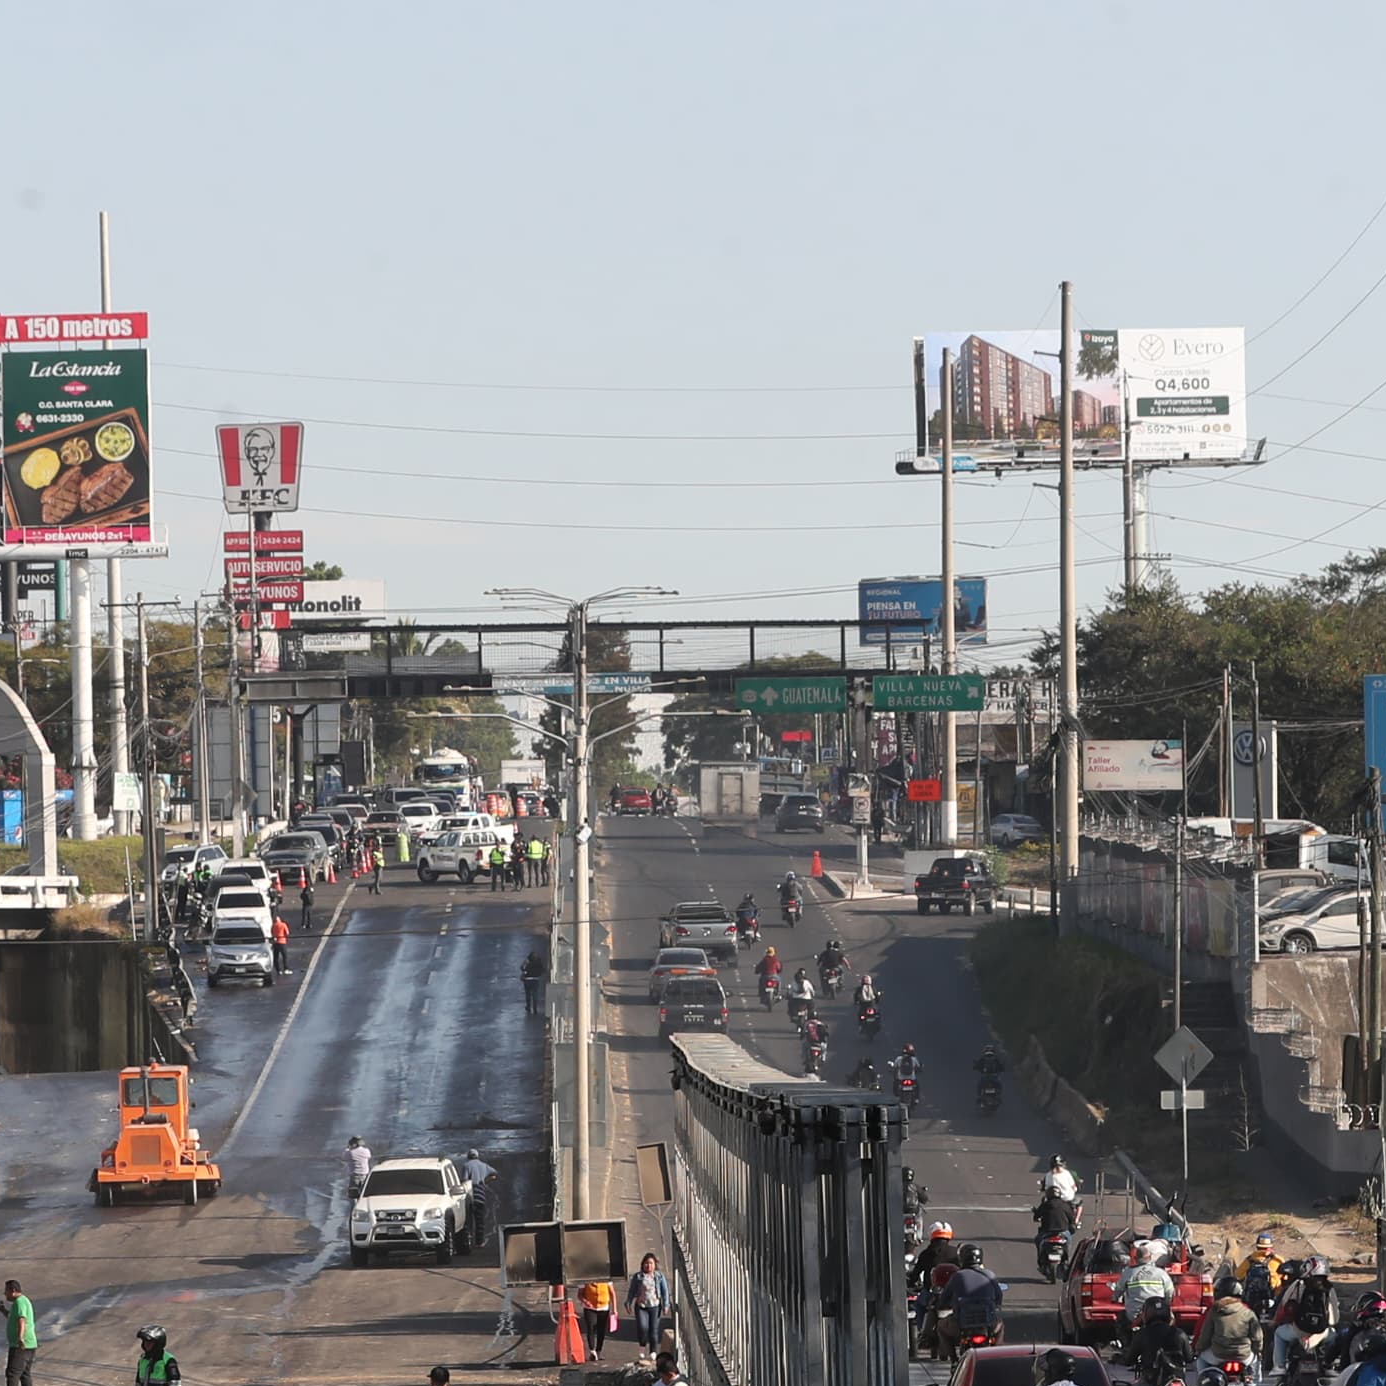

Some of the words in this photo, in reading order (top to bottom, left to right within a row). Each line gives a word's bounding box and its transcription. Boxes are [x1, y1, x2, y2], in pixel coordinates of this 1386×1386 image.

[5, 318, 19, 339] A
[24, 317, 59, 339] 150
[63, 318, 133, 338] metros
[1155, 377, 1210, 392] Q4,600
[55, 400, 83, 409] SANTA
[84, 400, 114, 408] CLARA
[867, 601, 902, 611] PIENSA
[903, 601, 916, 610] EN
[622, 676, 652, 684] VILLA
[878, 681, 914, 692] VILLA
[923, 680, 962, 692] NUEVA
[782, 687, 841, 704] GUATEMALA
[887, 695, 954, 707] BARCENAS
